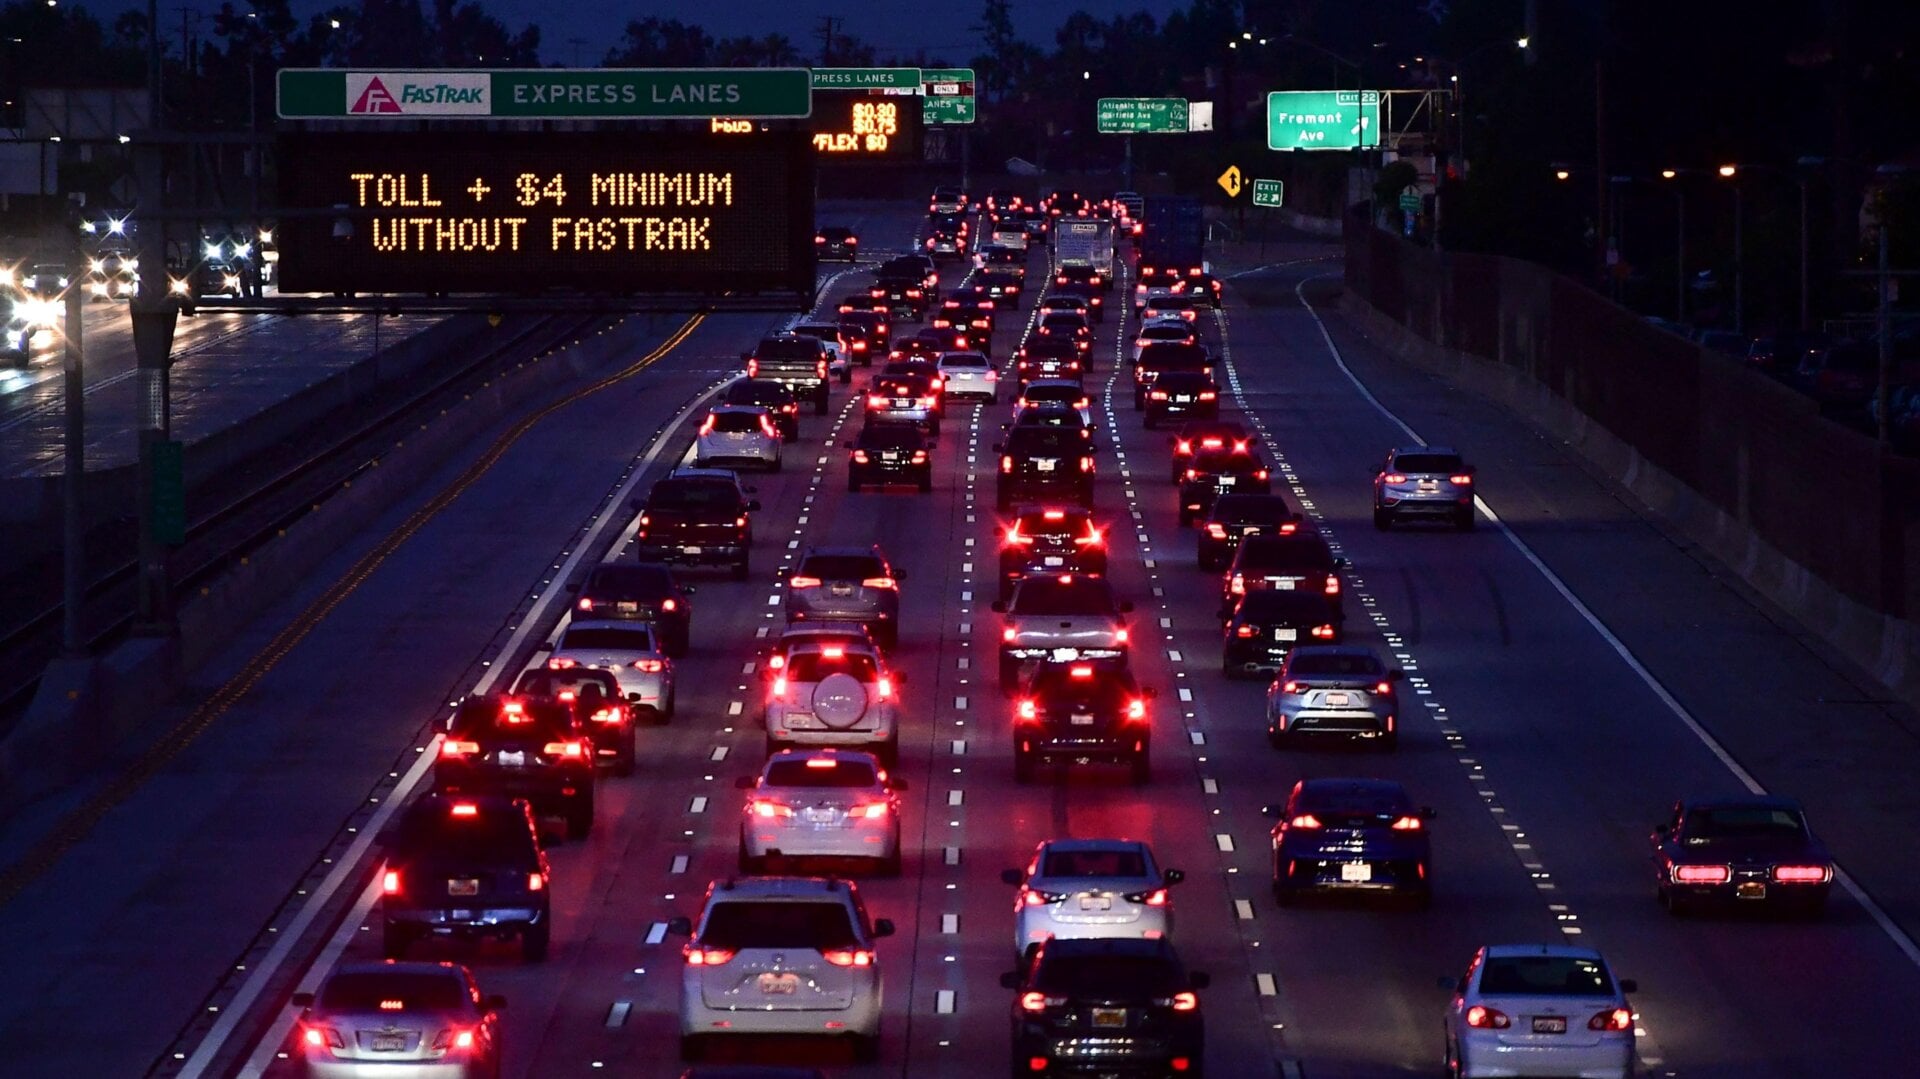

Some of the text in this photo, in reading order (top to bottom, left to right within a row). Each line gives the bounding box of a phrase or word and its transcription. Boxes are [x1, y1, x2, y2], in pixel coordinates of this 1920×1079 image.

[856, 74, 895, 83] LANES
[513, 84, 741, 103] EXPRESS LANES
[1340, 93, 1376, 103] EXIT 22
[1102, 102, 1156, 110] Atlantic Blvd
[1279, 112, 1342, 124] Fremont
[853, 118, 896, 134] $0.75
[1121, 121, 1136, 129] Ave
[1299, 130, 1325, 141] Ave
[351, 173, 441, 207] TOLL
[516, 173, 567, 206] $4
[592, 173, 732, 206] MINIMUM
[1256, 193, 1268, 201] 22
[373, 217, 711, 251] WITHOUT FASTRAK
